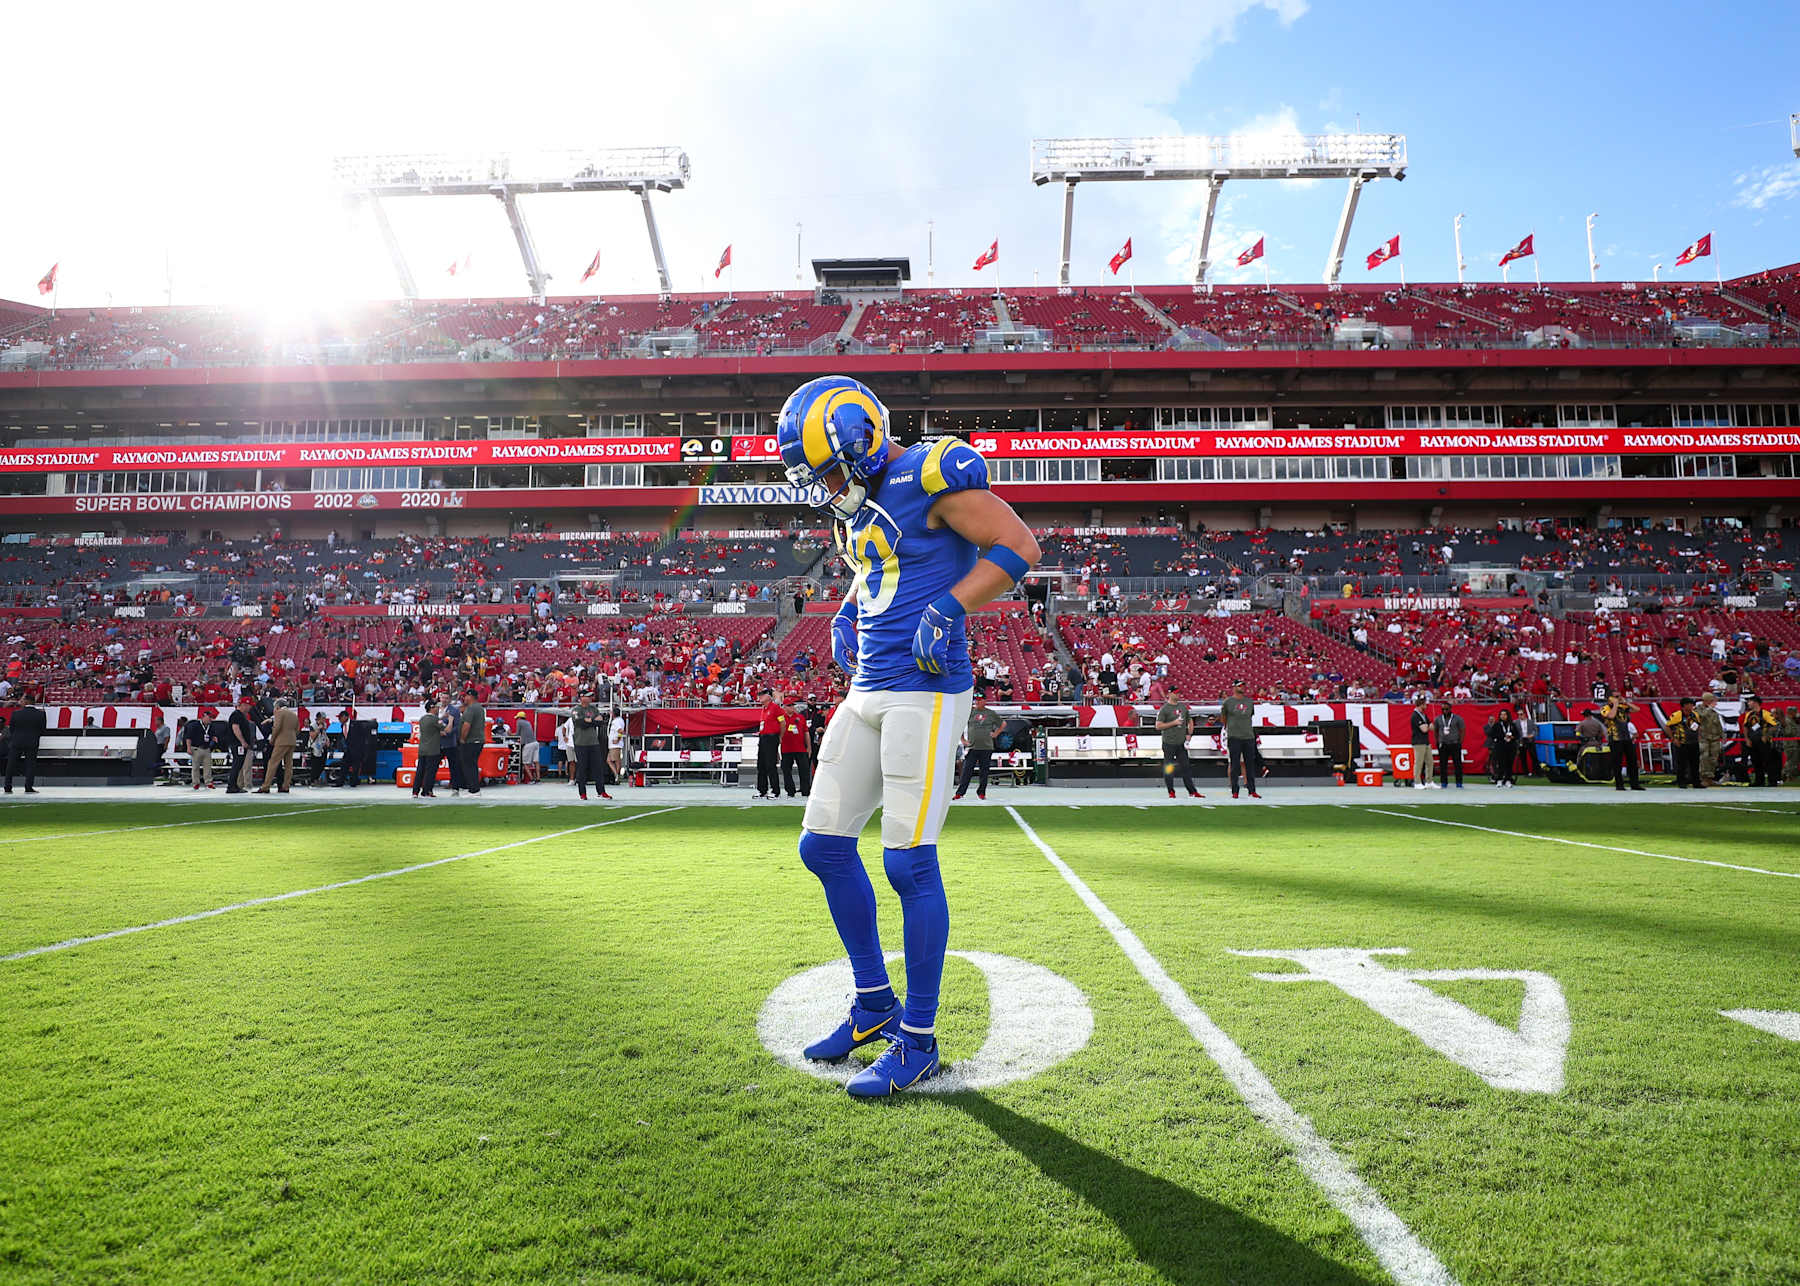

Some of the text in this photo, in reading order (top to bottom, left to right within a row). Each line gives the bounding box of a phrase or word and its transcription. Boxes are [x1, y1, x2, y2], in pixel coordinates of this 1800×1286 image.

[710, 439, 724, 453] 0
[764, 438, 778, 453] 0
[973, 438, 998, 452] 25
[1011, 438, 1082, 451] RAYMOND
[1083, 438, 1129, 450] JAMES
[1215, 437, 1286, 448] RAYMOND
[1287, 437, 1333, 448] JAMES
[1420, 435, 1490, 447] RAYMOND
[1491, 435, 1538, 447] JAMES
[1624, 435, 1695, 446] RAYMOND
[1696, 435, 1741, 446] JAMES
[112, 452, 177, 464] RAYMOND
[178, 451, 220, 463] JAMES
[300, 449, 366, 461] RAYMOND
[366, 448, 410, 460] JAMES
[491, 445, 559, 458] RAYMOND
[560, 445, 605, 457] JAMES
[0, 454, 34, 465] AMES
[889, 474, 914, 485] RAMS
[314, 493, 353, 508] 2002
[401, 492, 441, 507] 2020
[701, 487, 809, 503] RAYMOND
[75, 494, 292, 511] SUPER BOWL CHAMPIONS
[587, 603, 620, 615] #GOBUCS
[711, 602, 746, 614] #GOBUCS
[1593, 687, 1606, 699] 12
[497, 757, 505, 771] G
[1395, 752, 1411, 771] G
[402, 773, 412, 784] G
[1363, 773, 1374, 785] G
